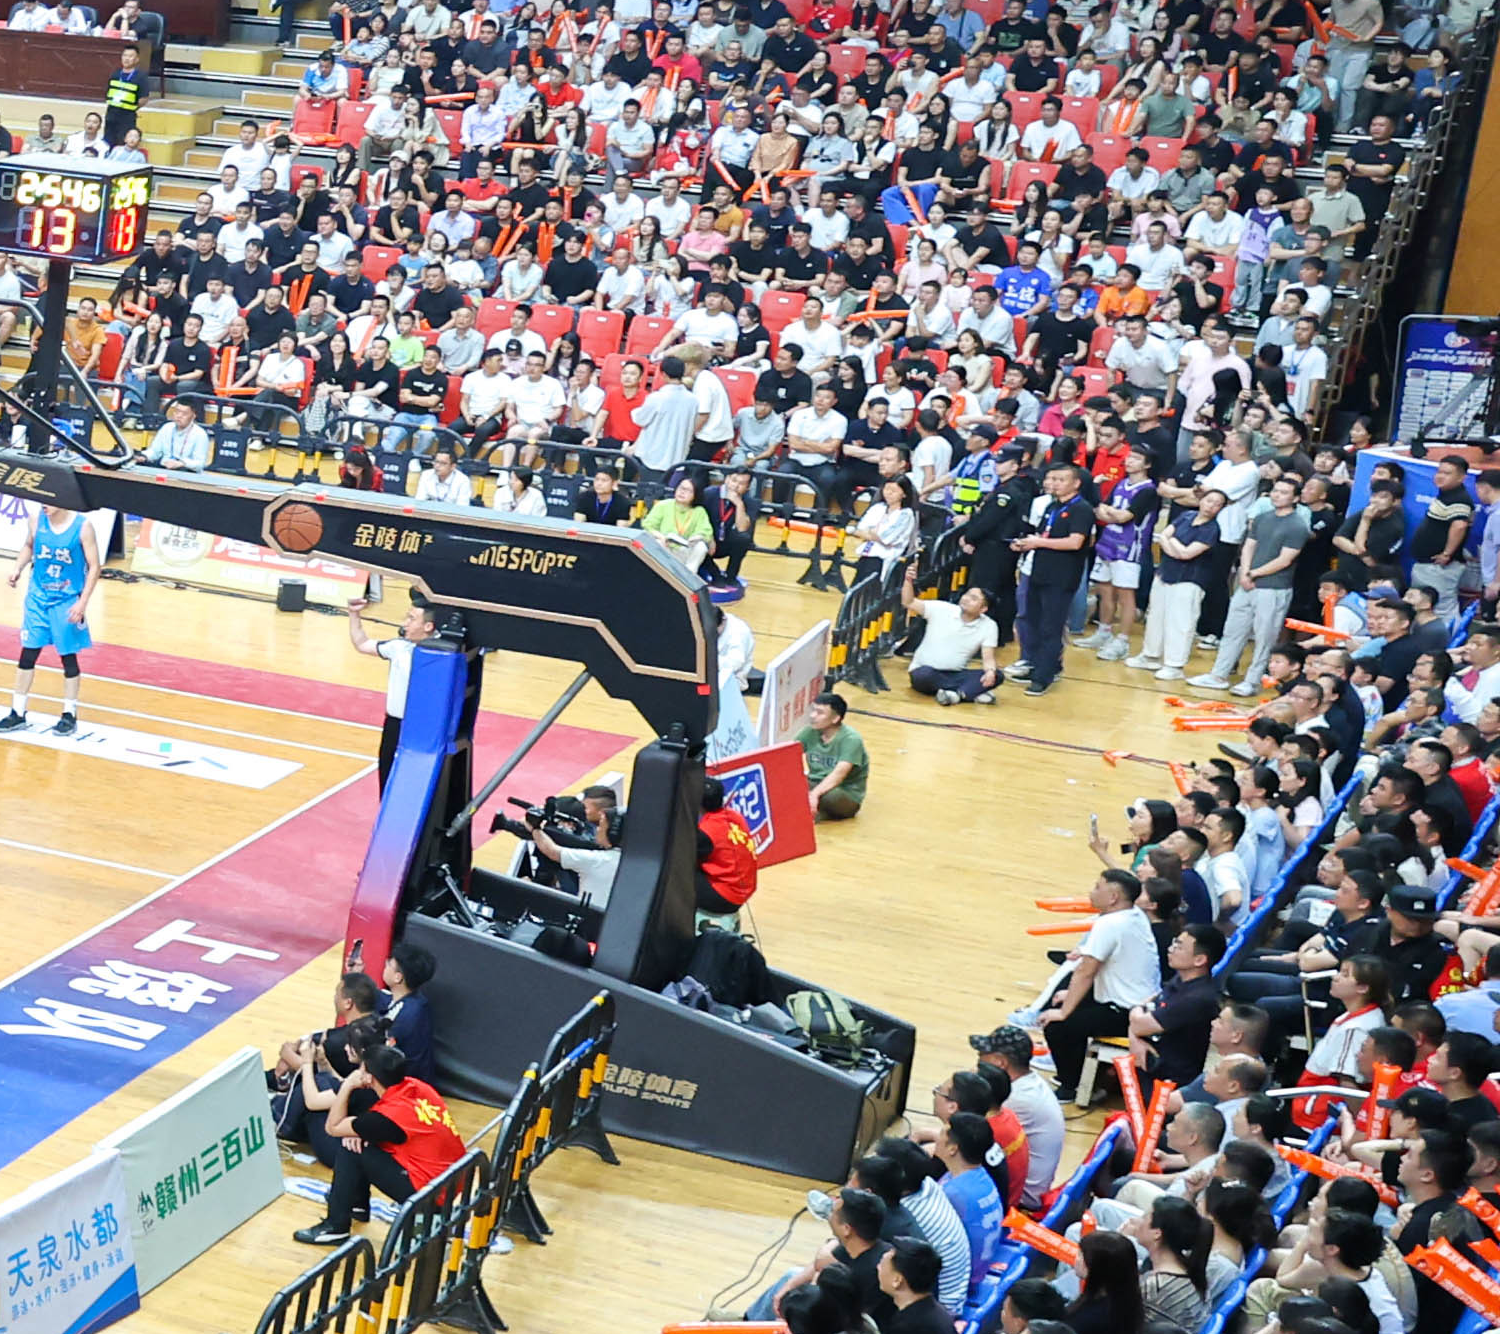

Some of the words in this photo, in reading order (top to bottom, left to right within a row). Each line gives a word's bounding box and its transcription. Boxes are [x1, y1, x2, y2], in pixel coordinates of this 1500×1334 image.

[27, 207, 77, 255] 13
[109, 207, 138, 253] 13
[154, 1114, 265, 1220] 赣州三百山
[6, 1202, 119, 1297] 天泉水都
